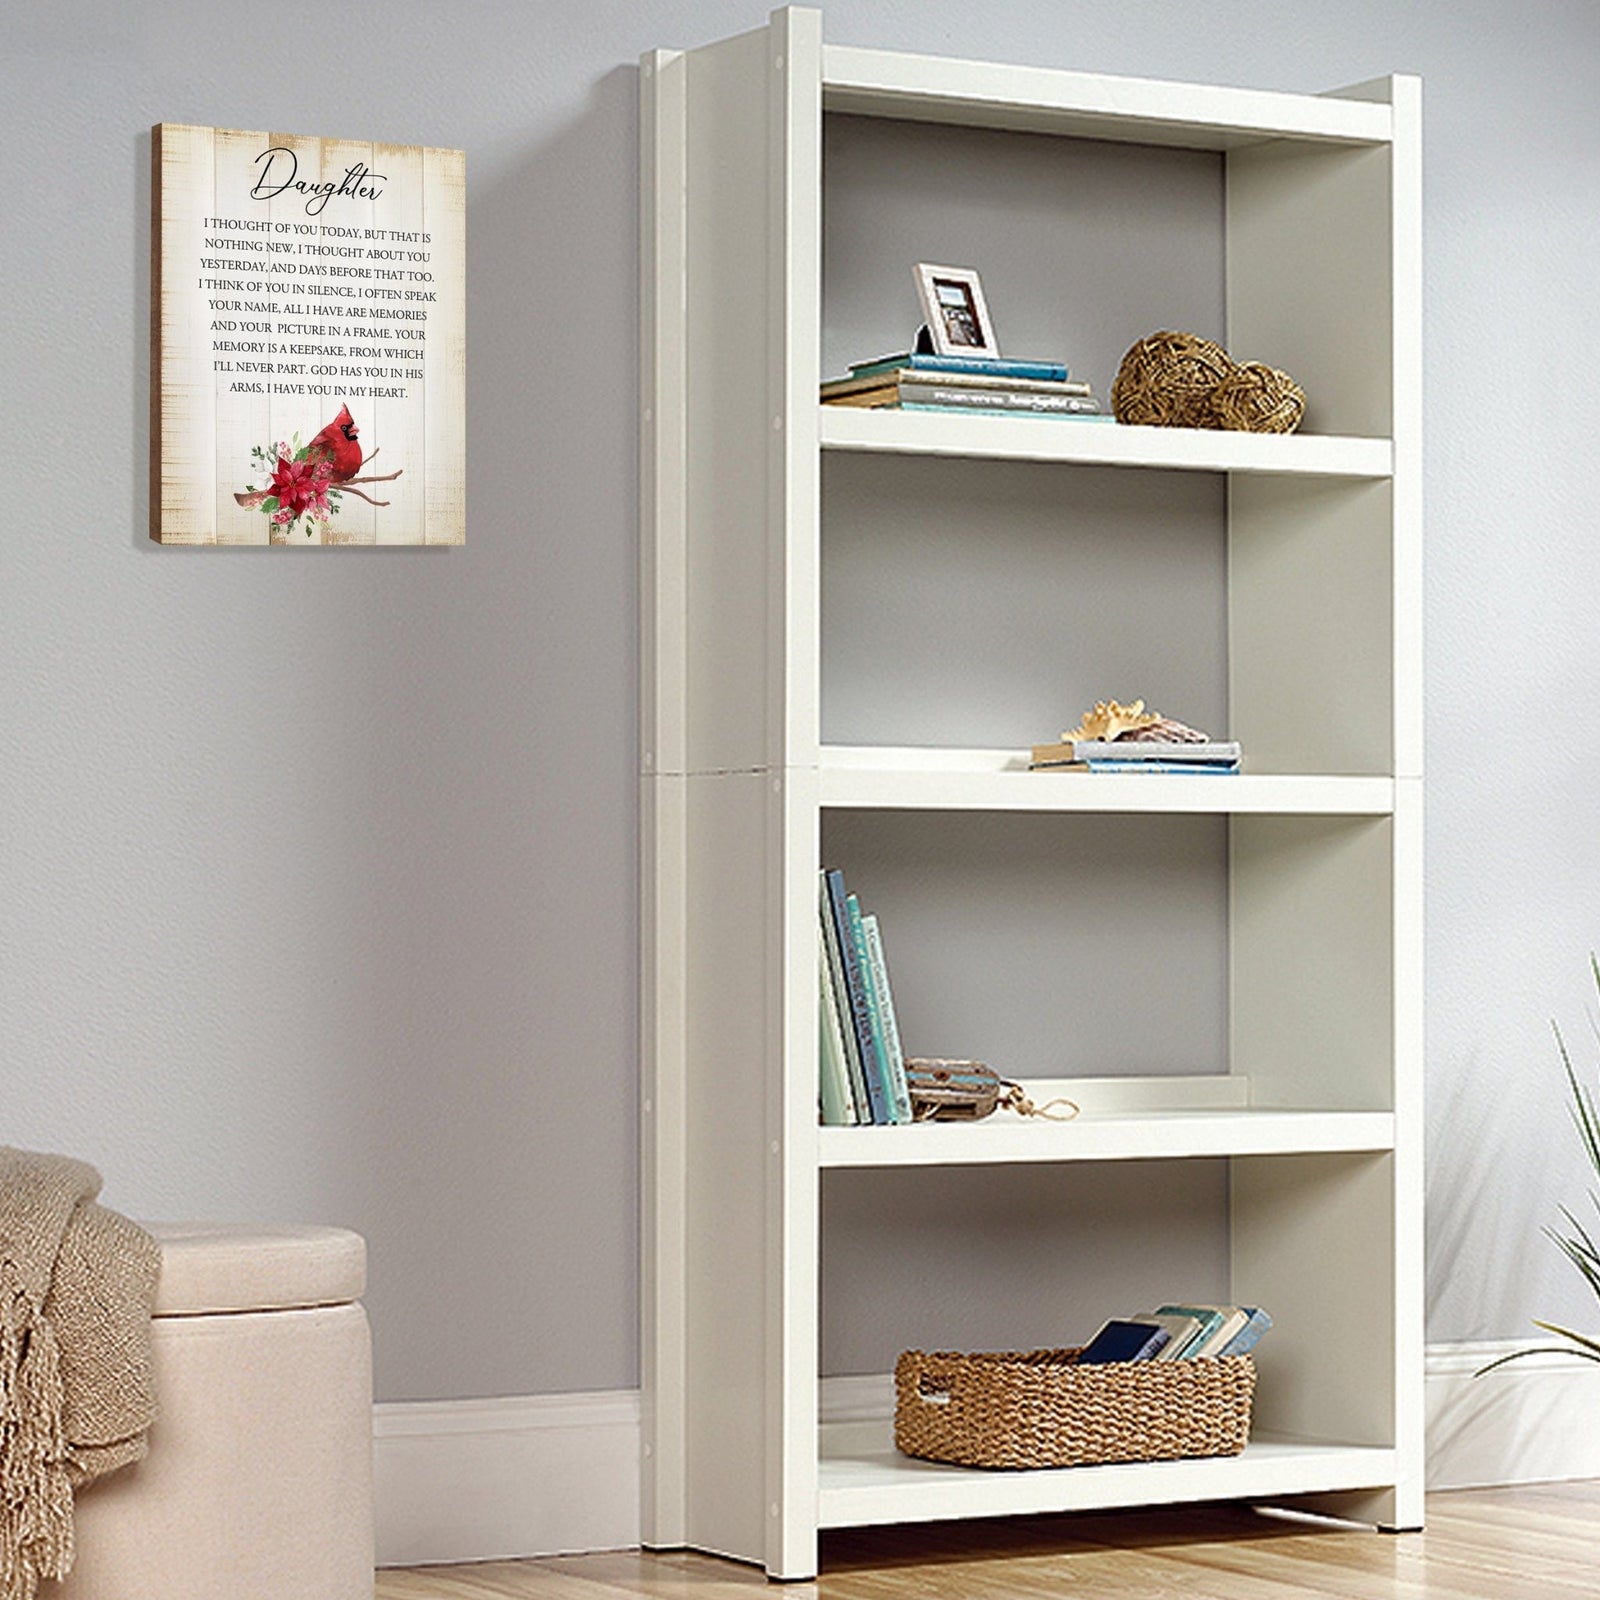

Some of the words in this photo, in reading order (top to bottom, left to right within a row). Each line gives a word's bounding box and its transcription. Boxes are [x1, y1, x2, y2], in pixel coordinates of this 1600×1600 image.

[249, 147, 388, 217] Daughter
[204, 217, 208, 228] I
[210, 218, 273, 232] THOUGHT
[275, 222, 291, 234] OF
[293, 224, 318, 236] YOU
[319, 226, 362, 239] TODAY,
[364, 229, 387, 240] BUT
[388, 231, 420, 242] THAT
[422, 233, 431, 244] IS
[205, 238, 263, 252] NOTHING
[266, 242, 296, 254] NEW,
[298, 244, 302, 254] I
[304, 244, 365, 258] THOUGHT
[366, 249, 405, 261] ABOUT
[406, 251, 430, 263] YOU
[200, 258, 268, 272] YESTERDAY,
[270, 263, 297, 274] AND
[299, 264, 327, 276] DAYS
[329, 266, 372, 278] BEFORE
[373, 269, 405, 280] THAT
[406, 271, 435, 282] TOO.
[198, 278, 202, 289] I
[204, 279, 244, 291] THINK
[246, 281, 263, 292] OF
[265, 282, 290, 294] YOU
[292, 284, 305, 294] IN
[307, 285, 356, 298] SILENCE,
[358, 287, 362, 298] I
[364, 288, 402, 300] OFTEN
[404, 290, 437, 302] SPEAK
[208, 299, 242, 311] YOUR
[244, 301, 281, 314] NAME,
[283, 304, 304, 315] ALL
[306, 304, 310, 315] I
[313, 305, 344, 317] HAVE
[345, 307, 367, 318] ARE
[369, 308, 427, 321] MEMORIES
[210, 320, 237, 331] AND
[239, 321, 273, 333] YOUR
[277, 323, 326, 336] PICTURE
[328, 326, 341, 336] IN
[343, 327, 351, 337] A
[353, 327, 393, 339] FRAME.
[395, 329, 426, 340] YOUR
[212, 341, 266, 353] MEMORY
[268, 343, 278, 354] IS
[279, 344, 288, 354] A
[290, 344, 347, 357] KEEPSAKE,
[349, 347, 381, 358] FROM
[383, 348, 424, 360] WHICH
[214, 361, 234, 372] I'LL
[236, 362, 275, 373] NEVER
[277, 363, 308, 375] PART.
[310, 365, 338, 376] GOD
[340, 366, 362, 377] HAS
[364, 367, 388, 378] YOU
[390, 368, 403, 378] IN
[405, 369, 423, 379] HIS
[229, 382, 264, 393] ARMS,
[267, 383, 271, 394] I
[274, 383, 305, 395] HAVE
[307, 384, 332, 396] YOU
[334, 385, 347, 396] IN
[349, 386, 367, 397] MY
[369, 387, 408, 398] HEART.
